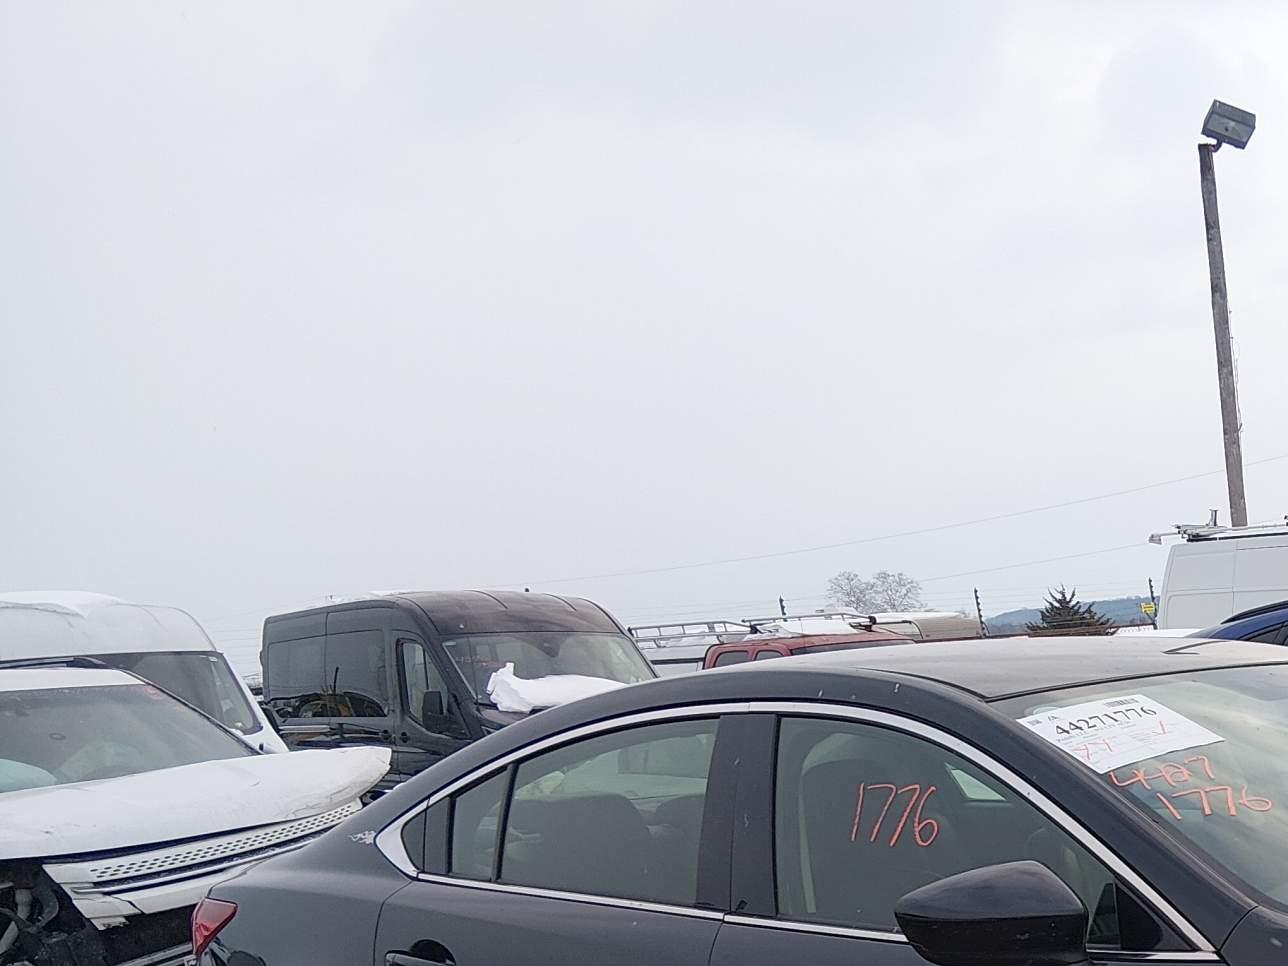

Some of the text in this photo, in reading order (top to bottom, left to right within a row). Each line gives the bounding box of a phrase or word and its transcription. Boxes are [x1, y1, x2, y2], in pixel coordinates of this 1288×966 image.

[1055, 705, 1157, 737] 44271776
[852, 782, 939, 847] 1776
[1156, 784, 1272, 820] 1776
